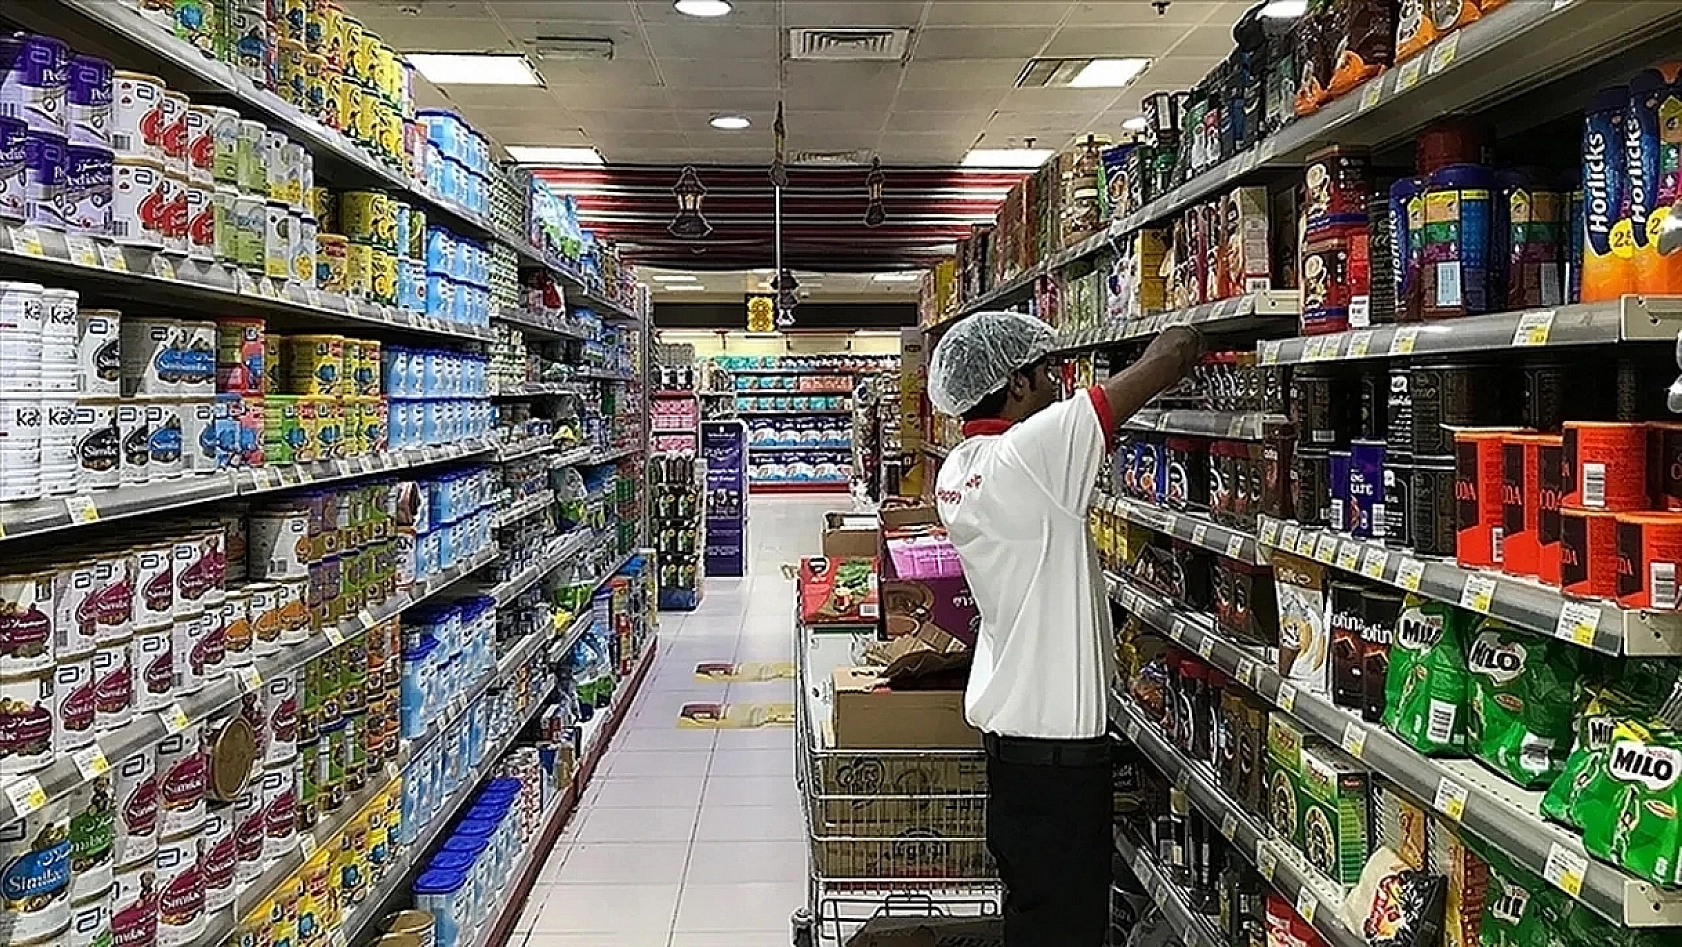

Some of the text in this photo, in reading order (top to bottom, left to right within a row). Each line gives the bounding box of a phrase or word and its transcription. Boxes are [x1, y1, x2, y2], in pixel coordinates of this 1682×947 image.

[1587, 132, 1610, 233] Horlicks
[1625, 116, 1646, 223] Horlicks
[1612, 747, 1673, 781] MILO
